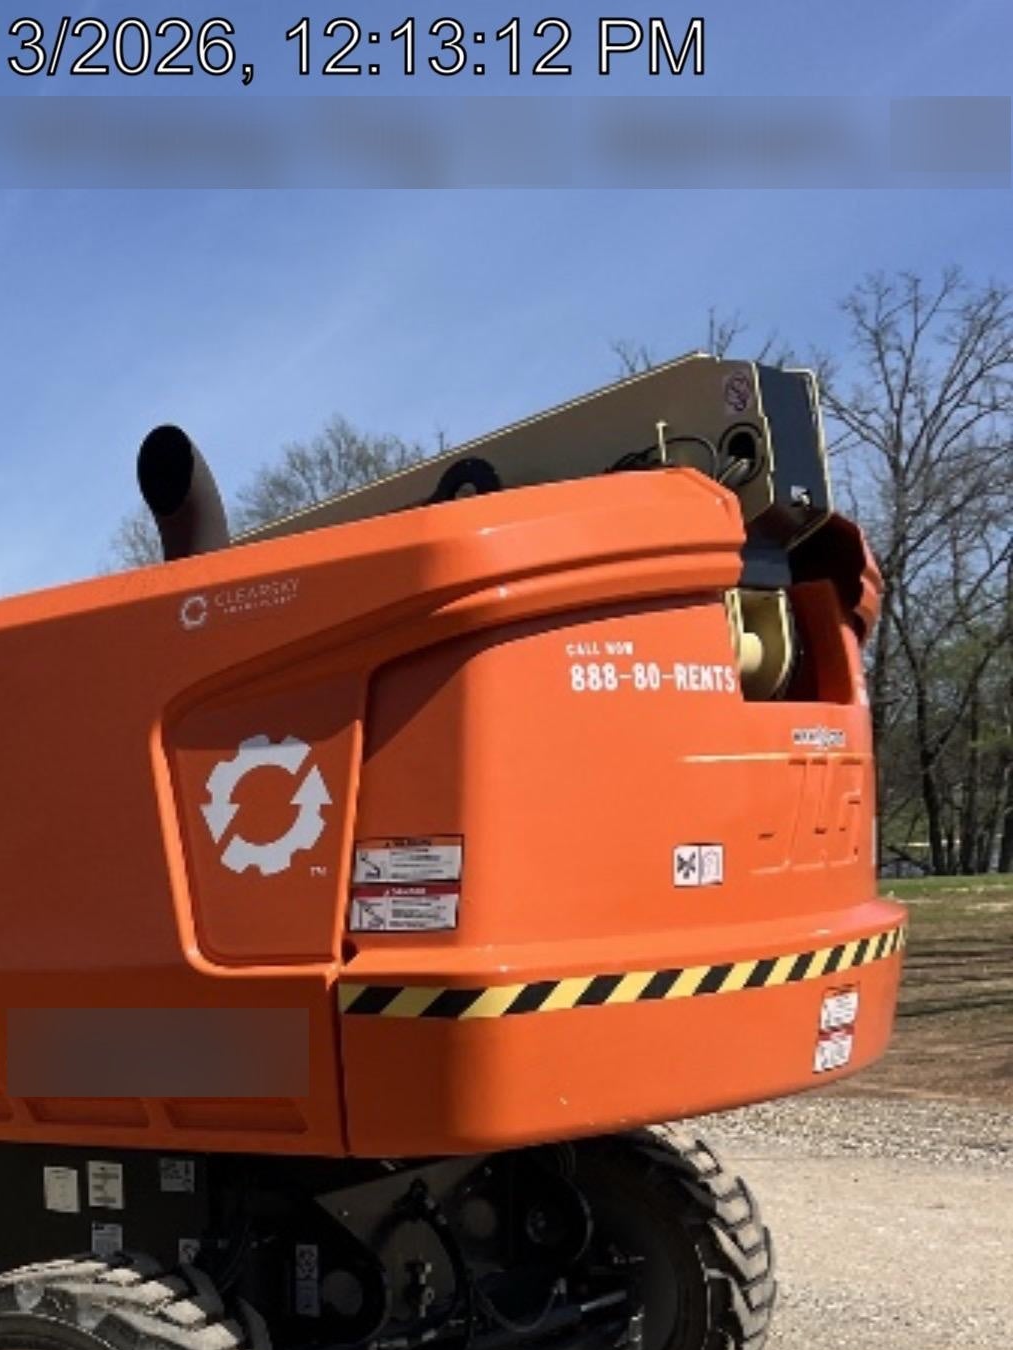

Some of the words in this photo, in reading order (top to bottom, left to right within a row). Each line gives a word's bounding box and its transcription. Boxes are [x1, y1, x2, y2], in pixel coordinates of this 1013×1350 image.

[566, 641, 600, 656] CALL
[604, 640, 634, 656] NOW
[571, 662, 736, 692] 888-80-RENTS
